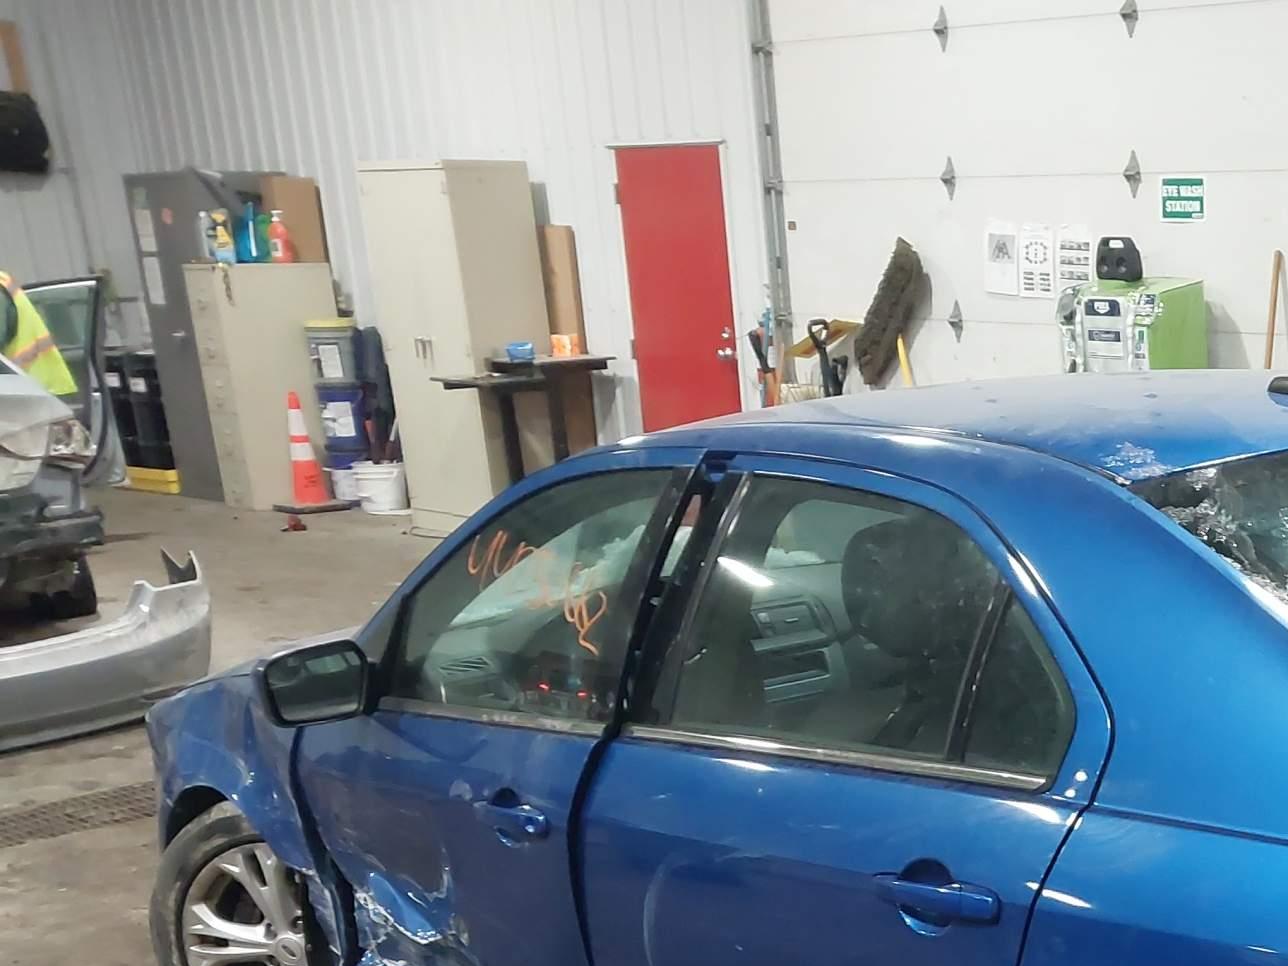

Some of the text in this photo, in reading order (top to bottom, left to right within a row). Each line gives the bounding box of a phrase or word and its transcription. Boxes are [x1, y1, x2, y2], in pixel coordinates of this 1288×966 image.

[1162, 185, 1204, 197] EYE WASH
[1165, 200, 1201, 212] STATION
